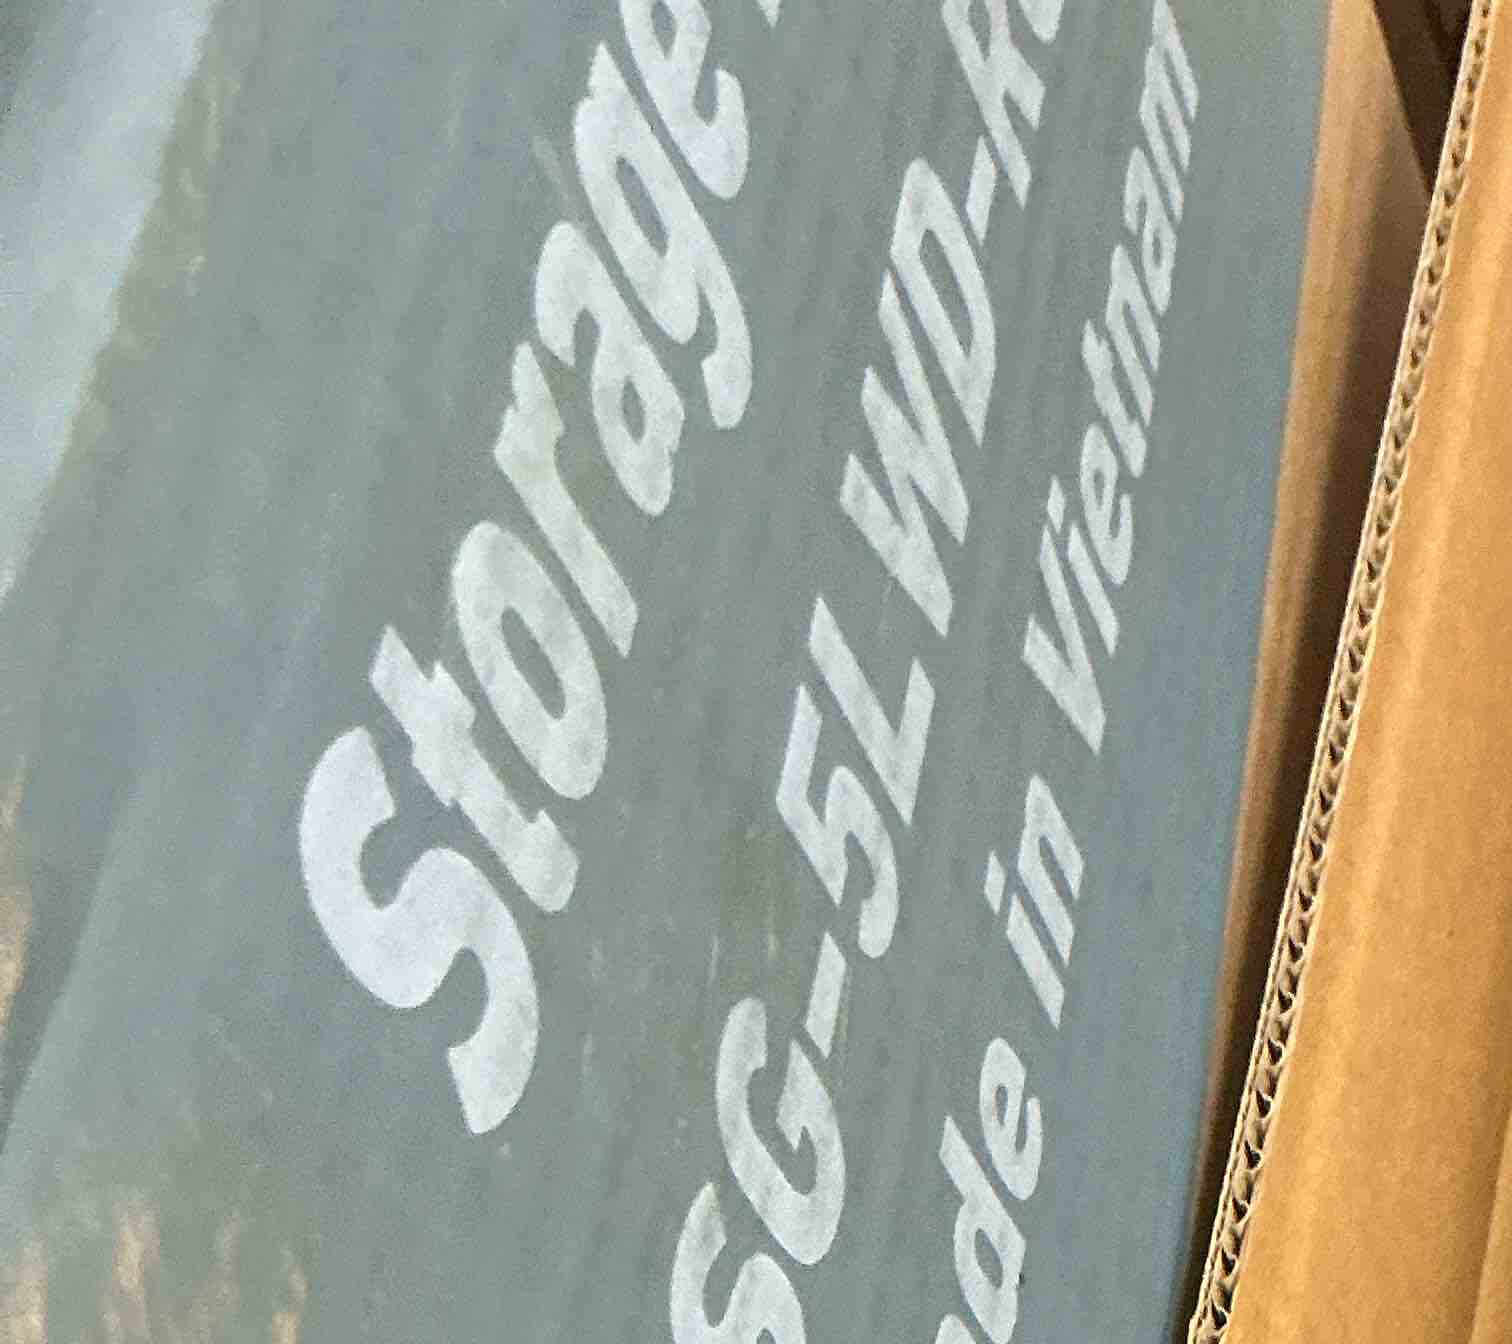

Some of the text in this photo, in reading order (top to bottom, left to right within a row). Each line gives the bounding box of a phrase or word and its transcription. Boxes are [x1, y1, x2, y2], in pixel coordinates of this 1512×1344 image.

[297, 0, 753, 1135] Storage
[840, 0, 1064, 638] WD-R
[1021, 0, 1199, 755] Vietnam
[984, 775, 1085, 1030] in
